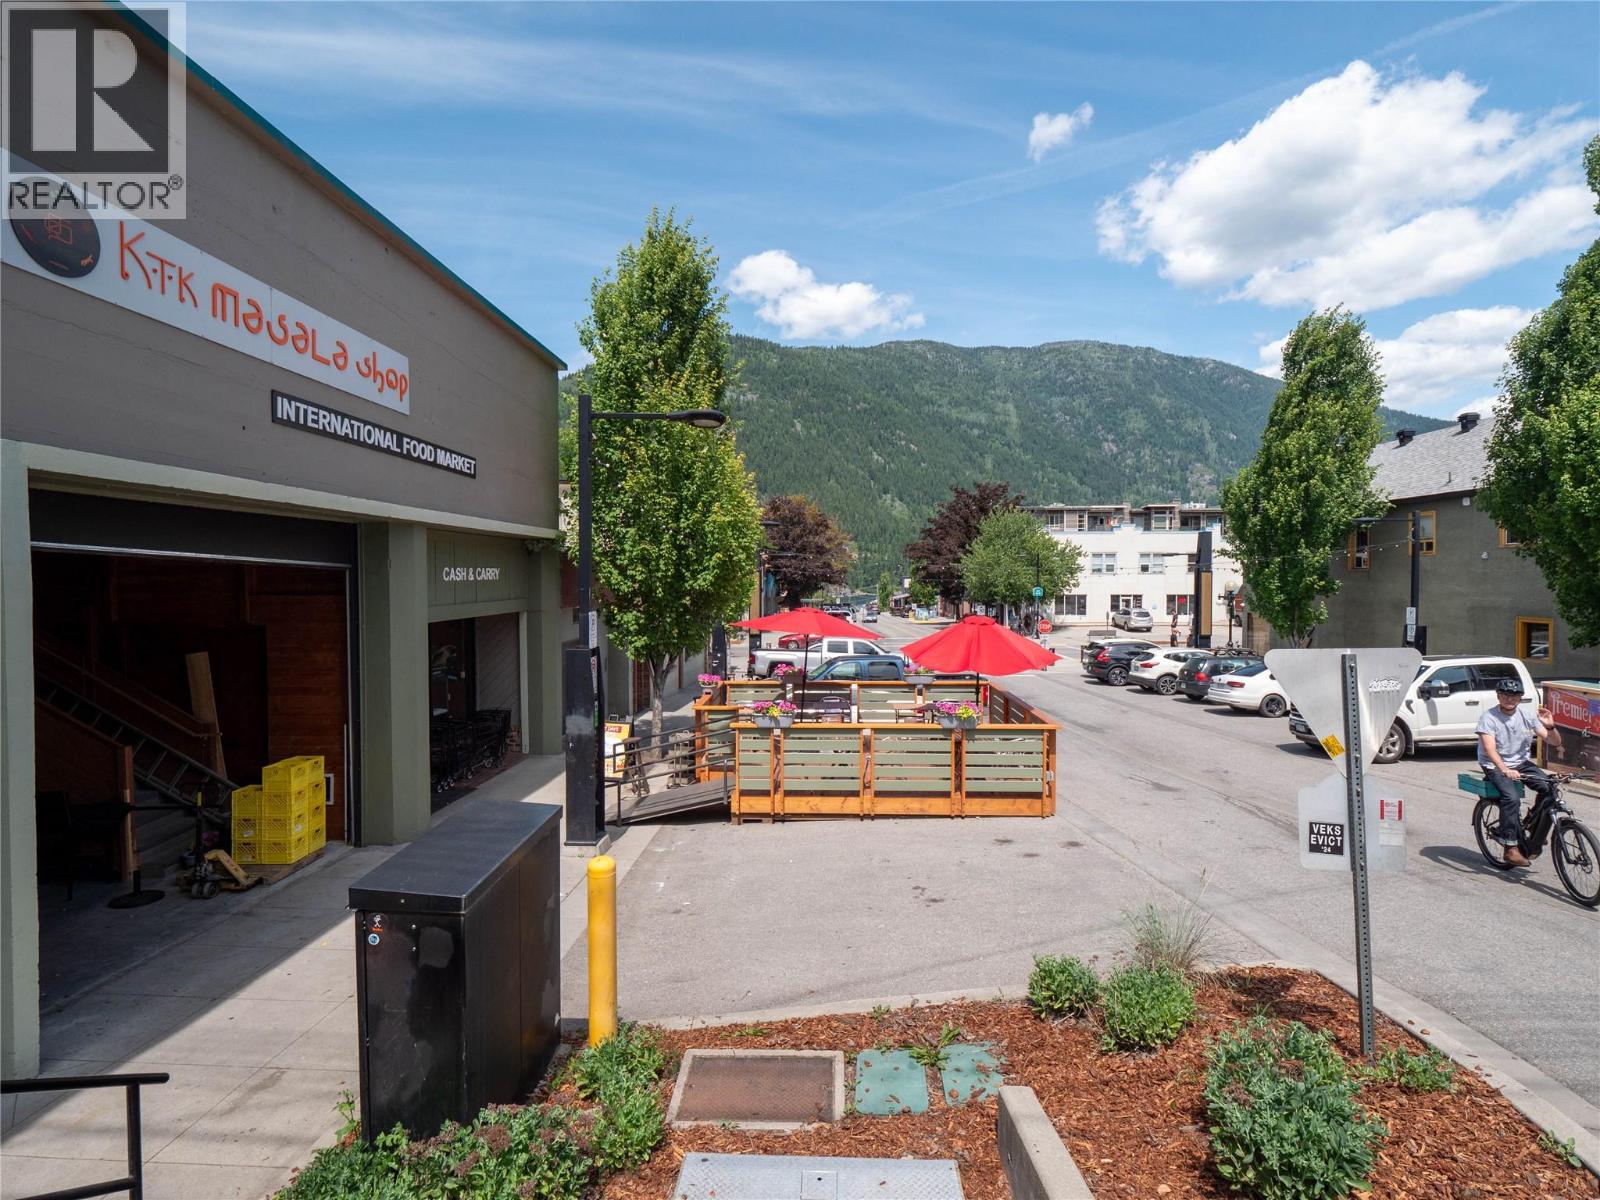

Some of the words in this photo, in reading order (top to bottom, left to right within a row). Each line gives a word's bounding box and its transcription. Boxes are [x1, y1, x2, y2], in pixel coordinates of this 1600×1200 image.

[276, 395, 401, 453] INTERNATIONAL
[402, 437, 436, 463] FOOD
[436, 449, 477, 475] MARKET
[442, 567, 467, 581] CASH
[468, 567, 475, 581] &
[475, 567, 501, 581] CARRY
[1312, 823, 1341, 836] VEKS
[1310, 834, 1343, 847] EVICT
